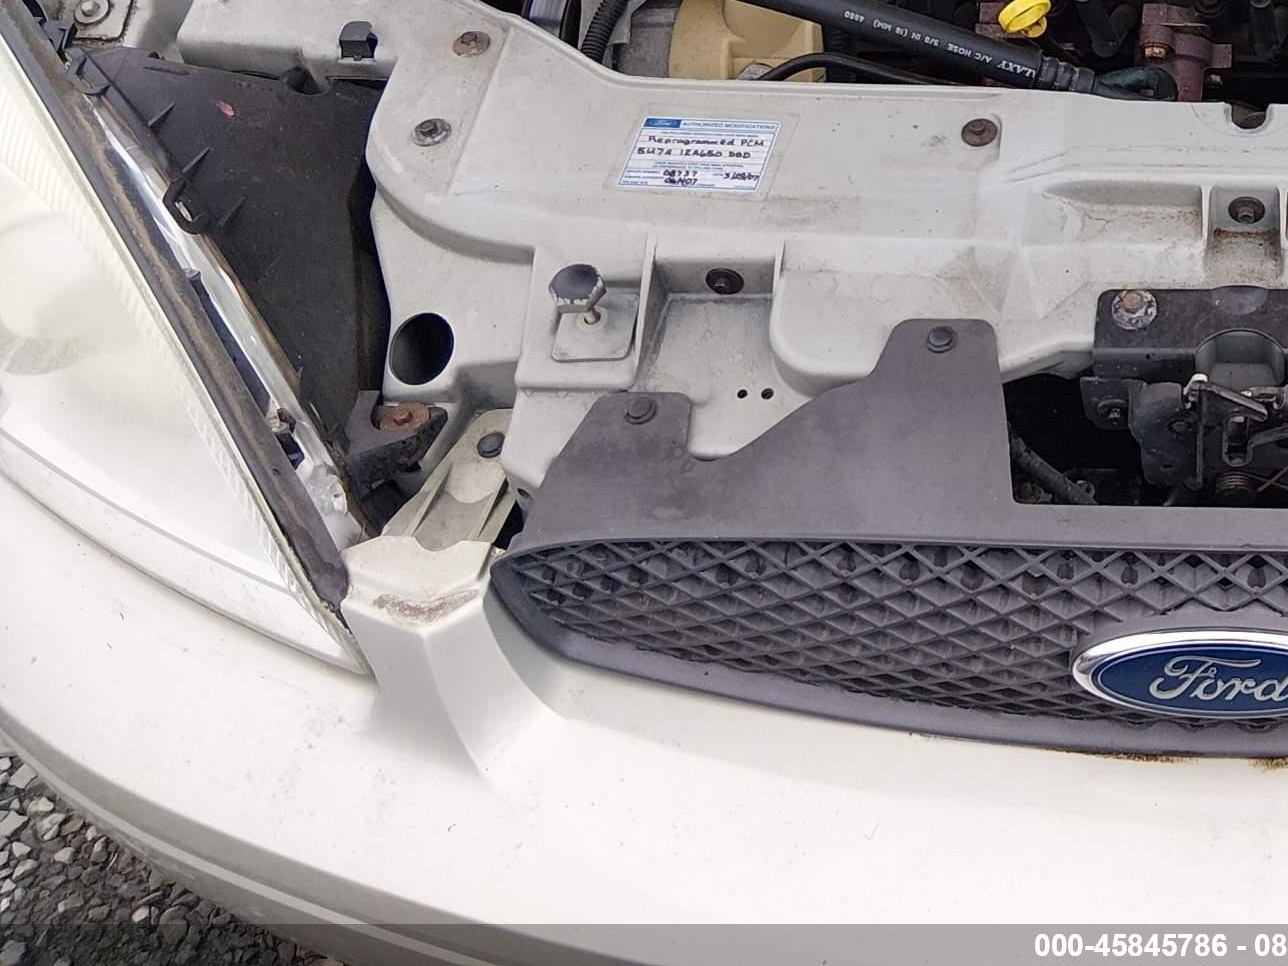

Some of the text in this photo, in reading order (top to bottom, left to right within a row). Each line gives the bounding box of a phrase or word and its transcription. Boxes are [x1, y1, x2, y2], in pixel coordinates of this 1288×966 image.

[947, 43, 972, 58] HOSE
[974, 52, 993, 63] A/C
[648, 135, 735, 146] Reprogrammed
